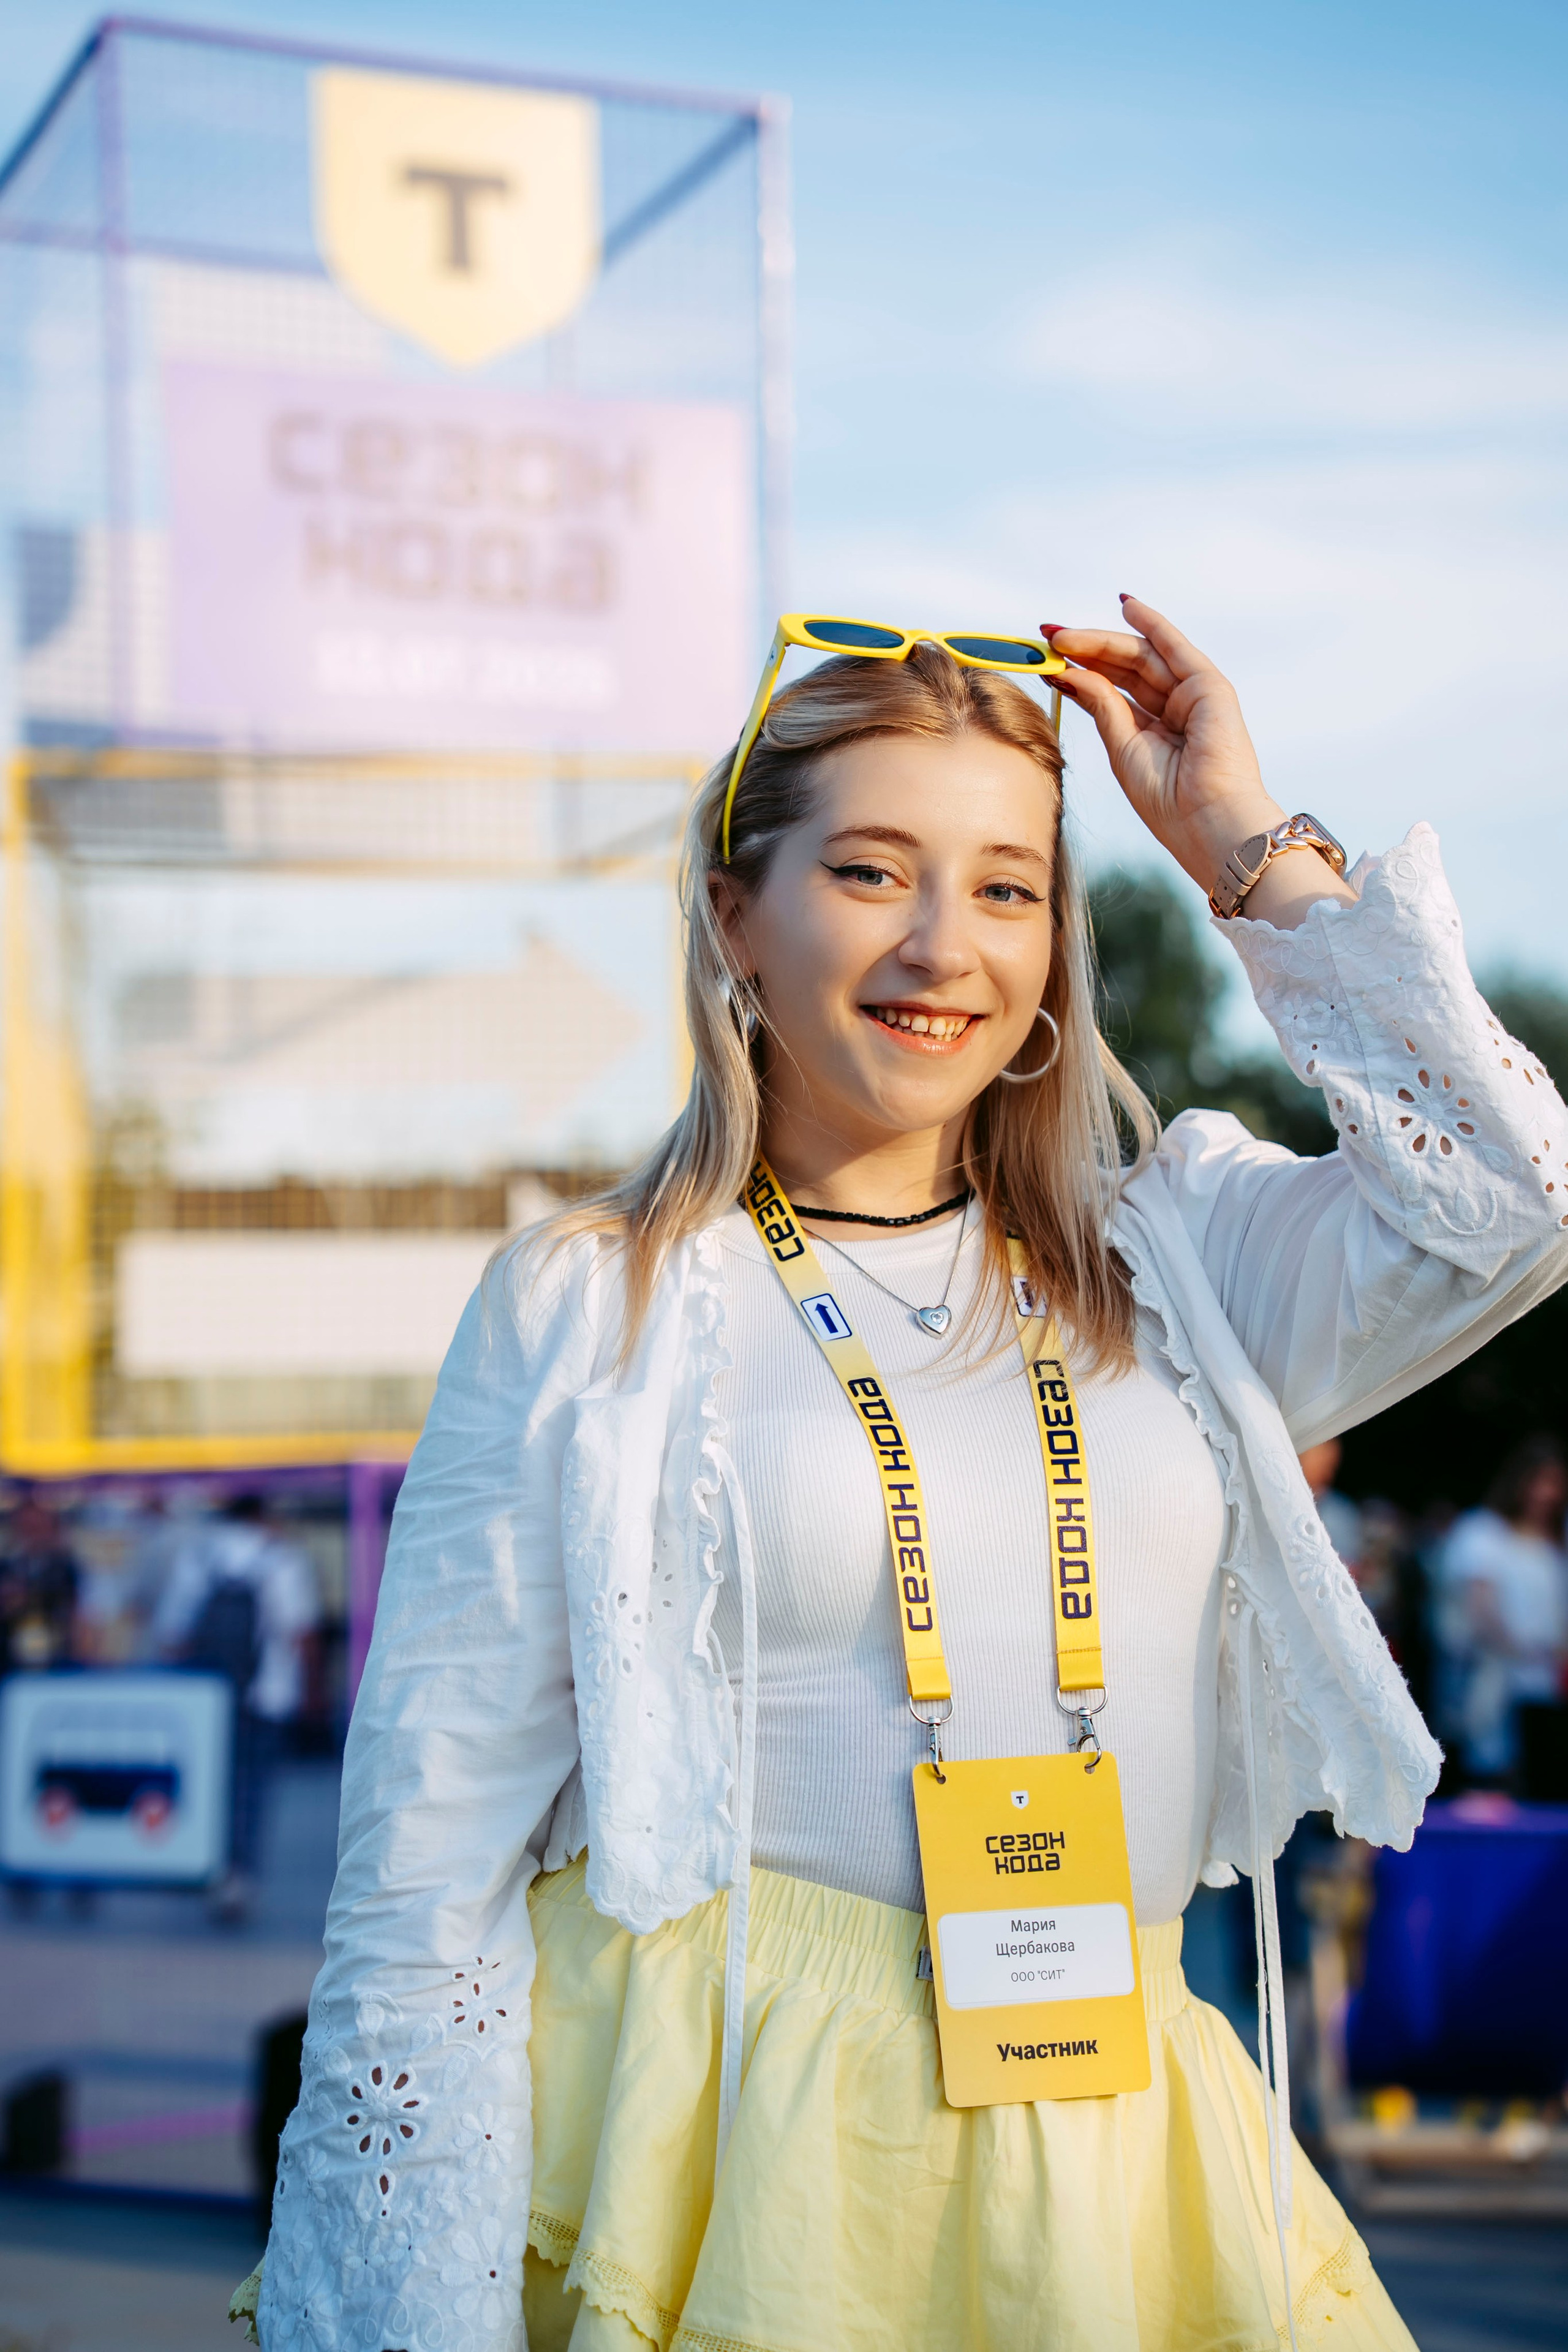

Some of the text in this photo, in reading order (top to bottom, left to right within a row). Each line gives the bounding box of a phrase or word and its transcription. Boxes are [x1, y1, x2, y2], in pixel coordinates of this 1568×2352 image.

[1011, 1920, 1056, 1934] Мария
[996, 1940, 1075, 1958] Щербакова
[1011, 1969, 1065, 1982] ООО "СИТ"
[997, 2040, 1098, 2062] Участник
